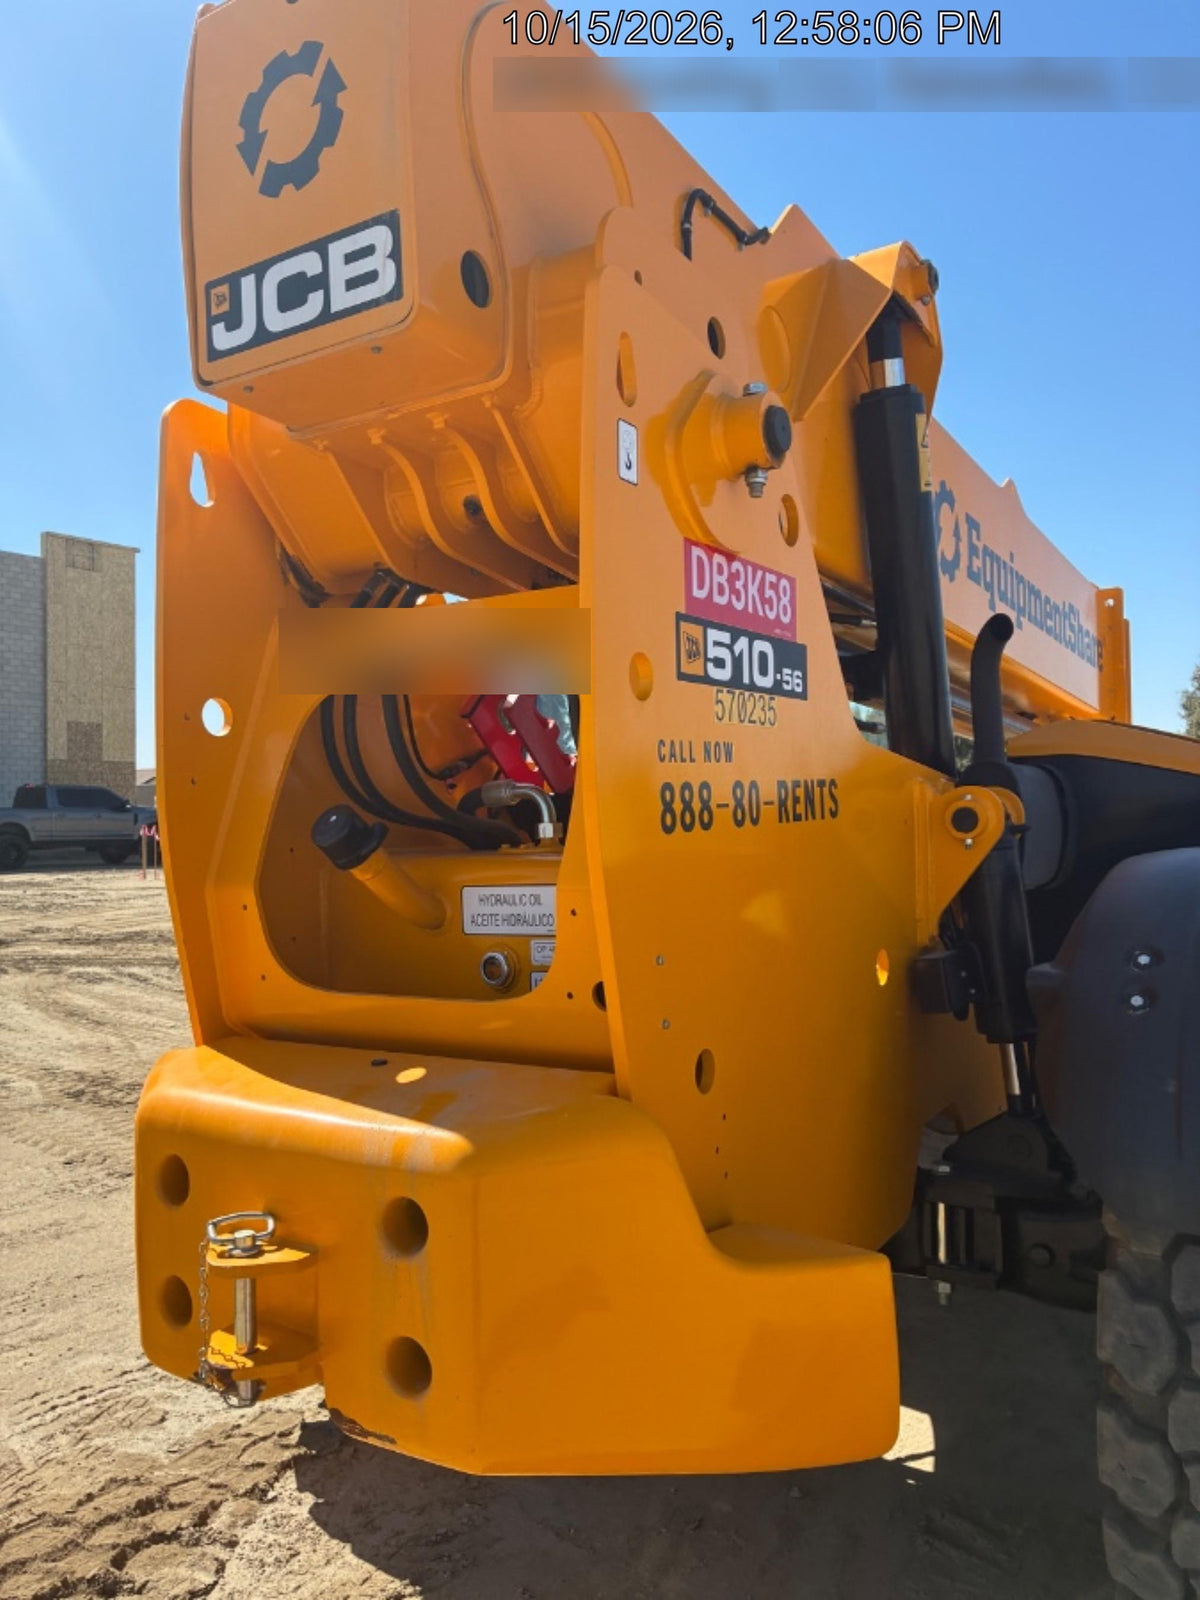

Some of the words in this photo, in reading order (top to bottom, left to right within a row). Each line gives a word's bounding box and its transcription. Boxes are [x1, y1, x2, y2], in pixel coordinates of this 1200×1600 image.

[211, 224, 397, 351] JCB
[691, 545, 792, 625] DB3K58
[965, 511, 1104, 673] EquipmentShare
[714, 688, 777, 727] 570235
[657, 739, 696, 763] CALL
[703, 740, 734, 764] NOW
[660, 778, 839, 835] 888-80-RENTS
[471, 913, 500, 927] ACEITE
[479, 893, 527, 907] HYDRAULIC
[529, 893, 543, 906] OIL
